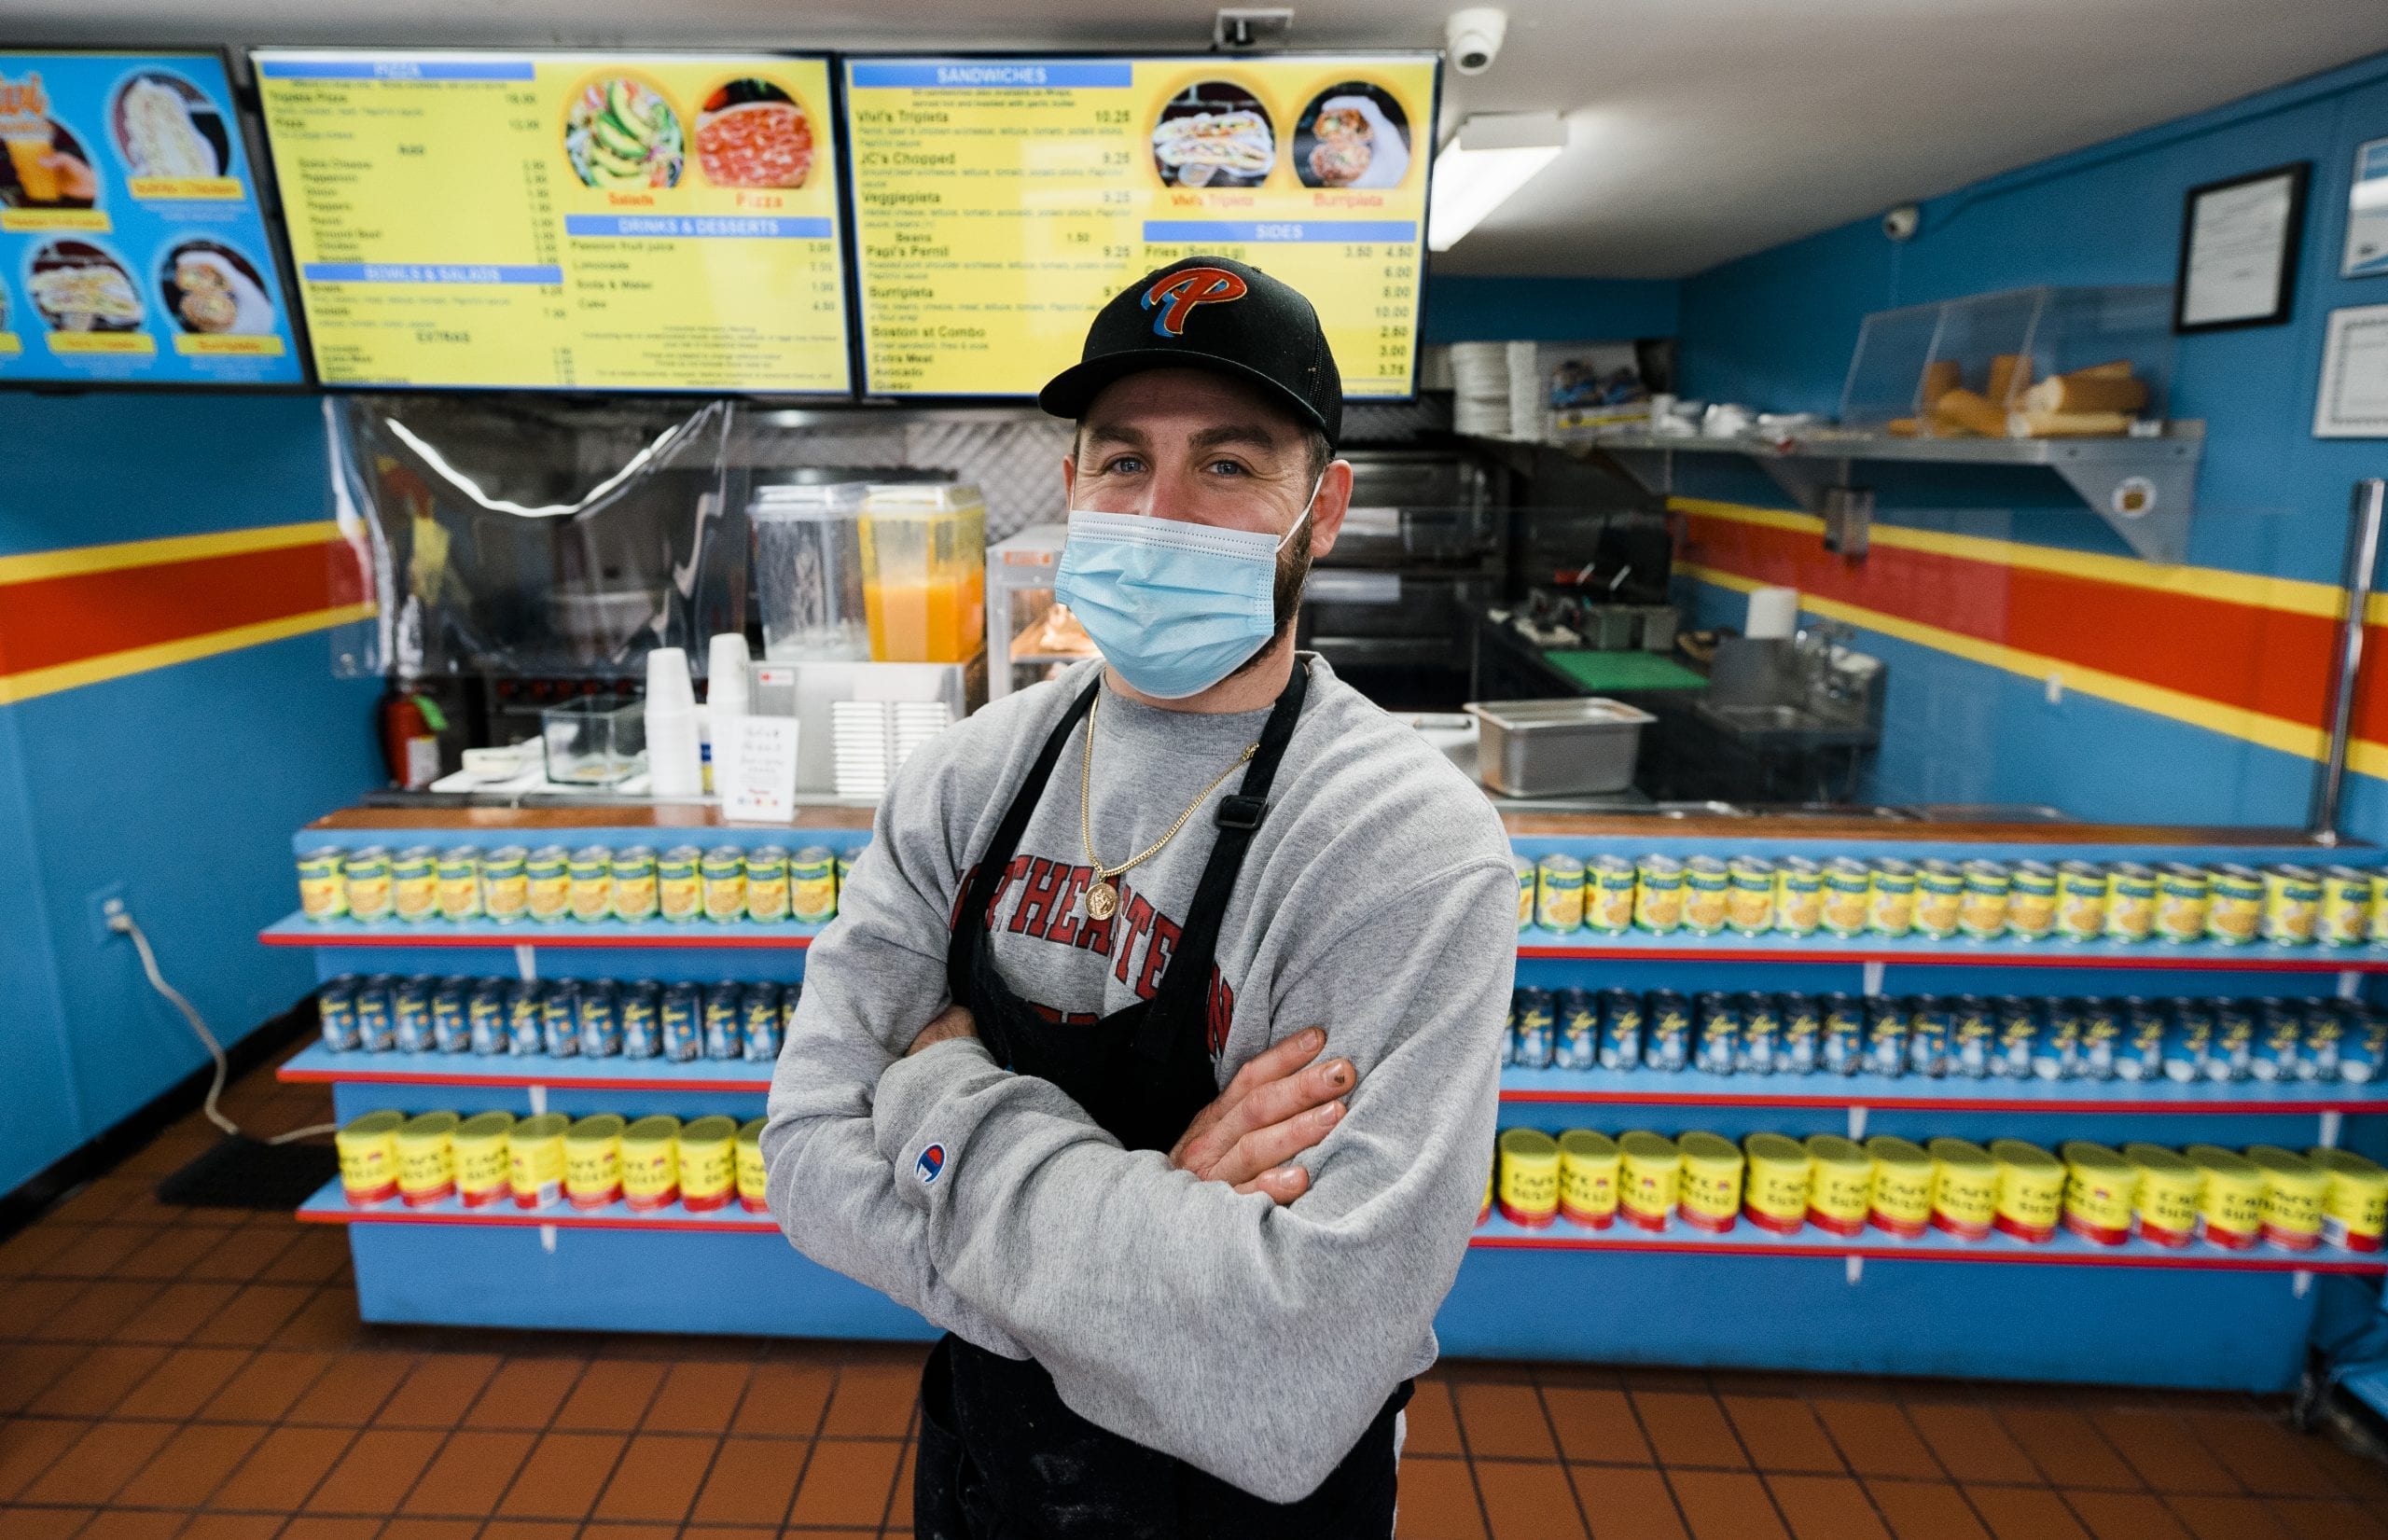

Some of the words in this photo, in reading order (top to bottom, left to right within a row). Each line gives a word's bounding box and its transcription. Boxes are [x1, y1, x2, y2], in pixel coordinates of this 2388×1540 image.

[937, 66, 1048, 84] SANDWICHES
[894, 153, 956, 169] Chopped
[735, 192, 784, 208] Pizza
[618, 220, 678, 234] DRINKS
[681, 222, 693, 234] &
[696, 221, 780, 235] DESSERTS
[1256, 224, 1304, 240] SIDES
[1145, 245, 1178, 257] Fries
[937, 326, 987, 339] Combo
